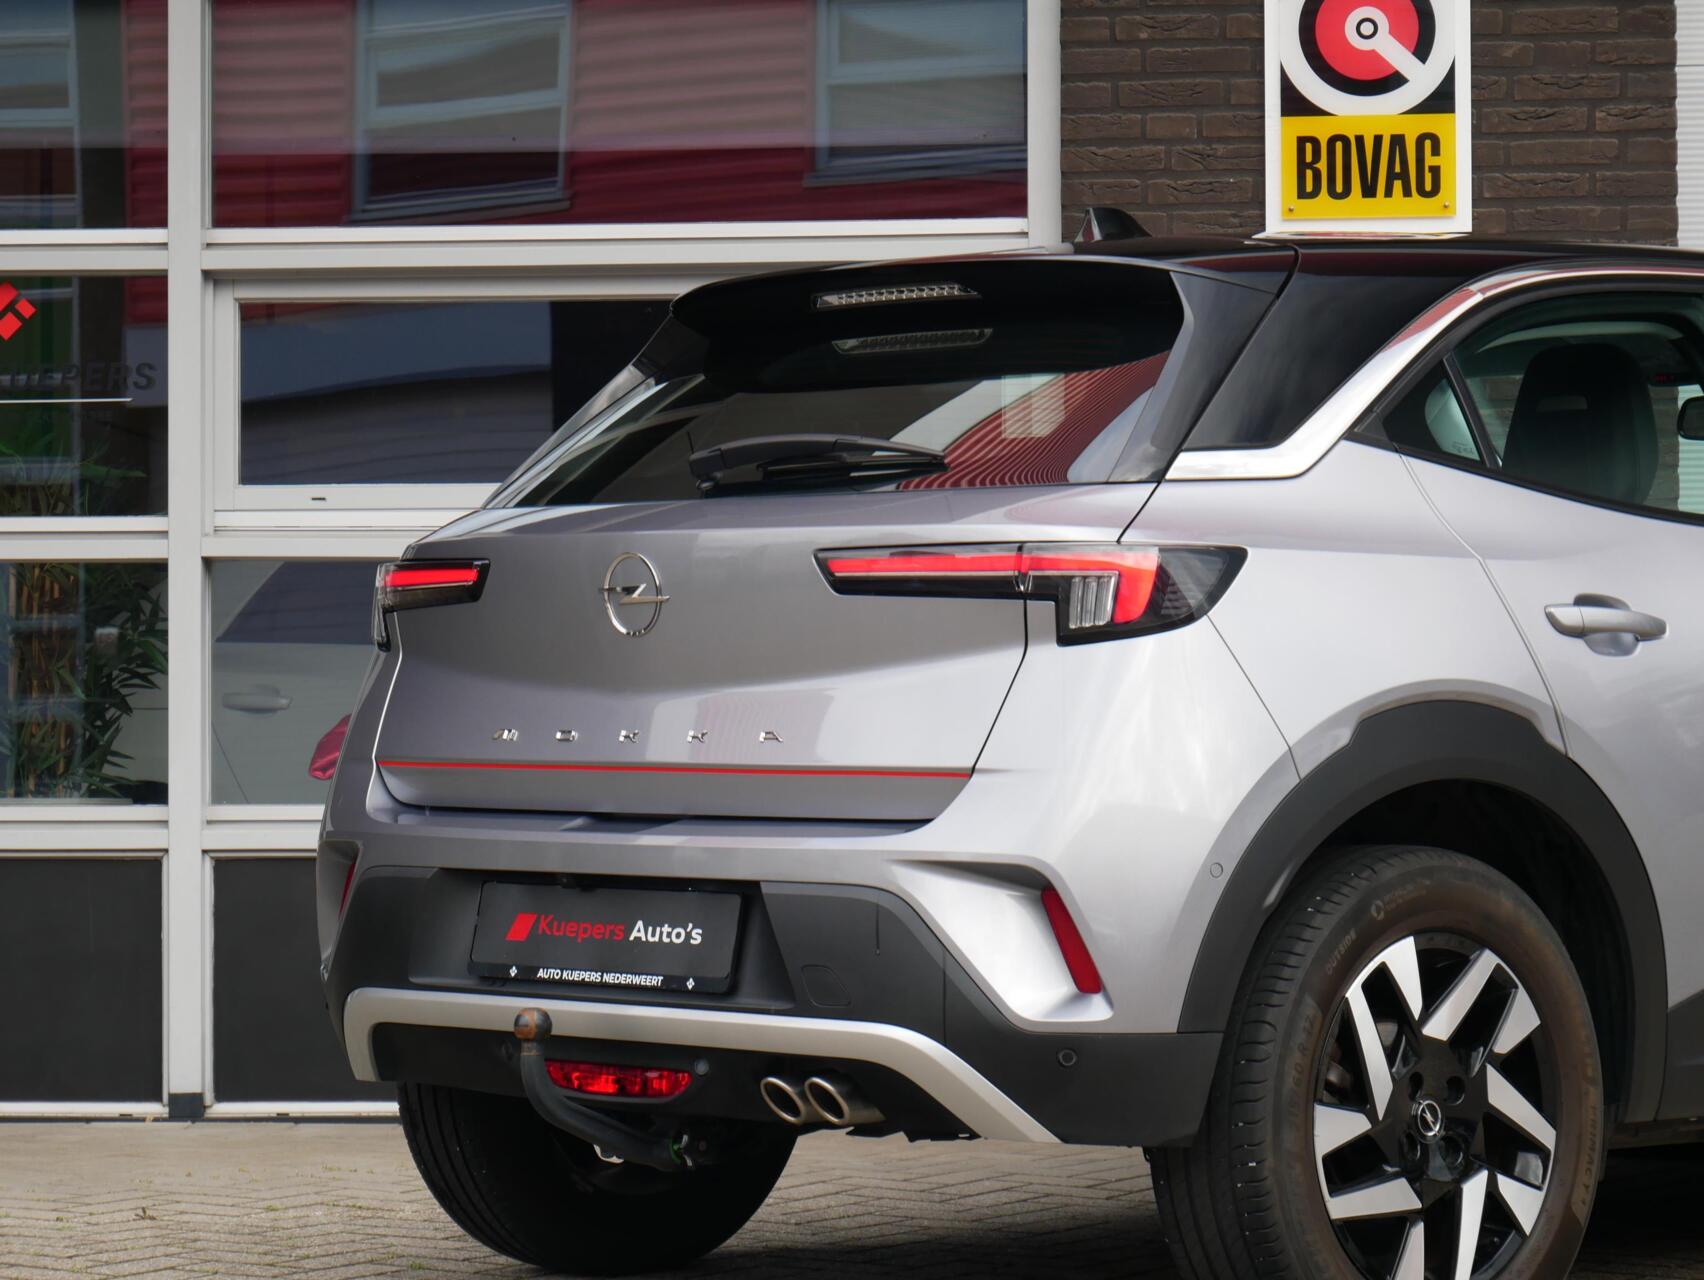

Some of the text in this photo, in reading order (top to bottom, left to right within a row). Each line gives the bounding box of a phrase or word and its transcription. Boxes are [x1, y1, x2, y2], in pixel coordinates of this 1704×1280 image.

[1296, 132, 1441, 200] BOVAG
[492, 728, 784, 744] MOKKA
[538, 913, 703, 944] Kuepers Auto's
[537, 968, 663, 986] AUTO KUEPERS NEDERWEERT
